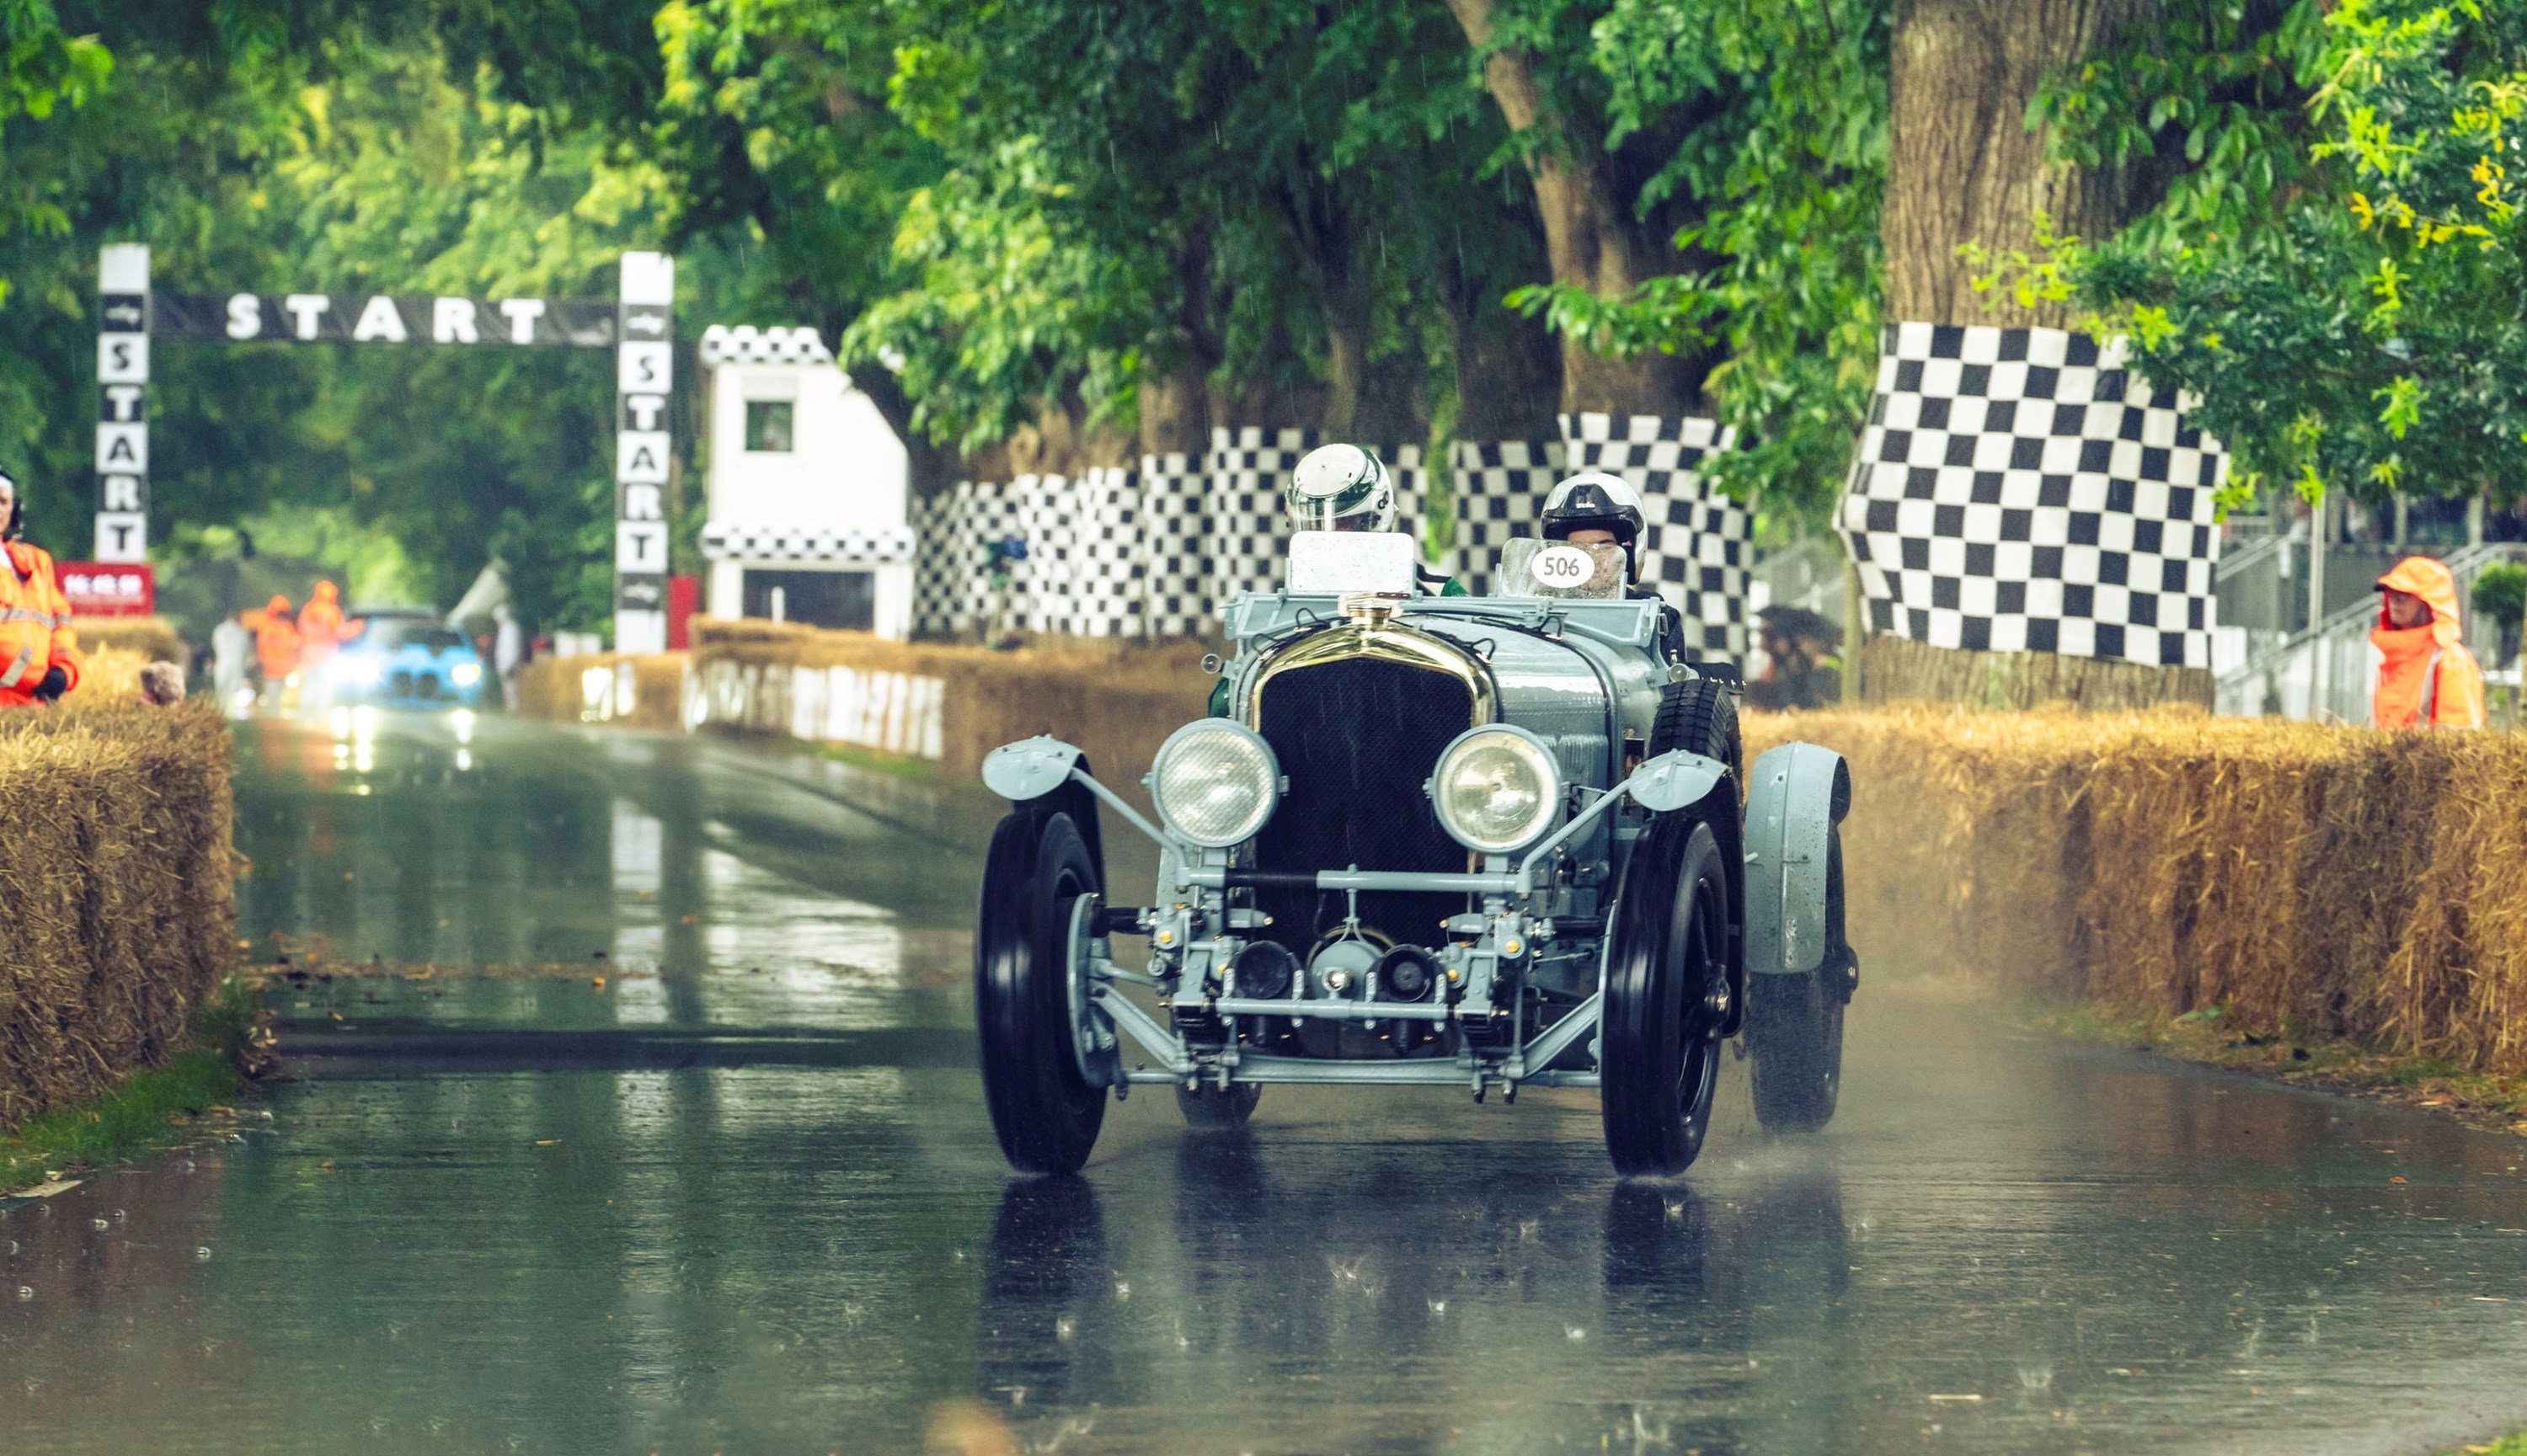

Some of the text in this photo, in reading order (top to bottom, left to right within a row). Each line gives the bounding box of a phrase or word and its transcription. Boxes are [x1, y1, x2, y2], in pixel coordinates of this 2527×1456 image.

[227, 293, 546, 344] START
[105, 343, 142, 552] START
[626, 355, 666, 560] START
[1543, 557, 1580, 577] 506
